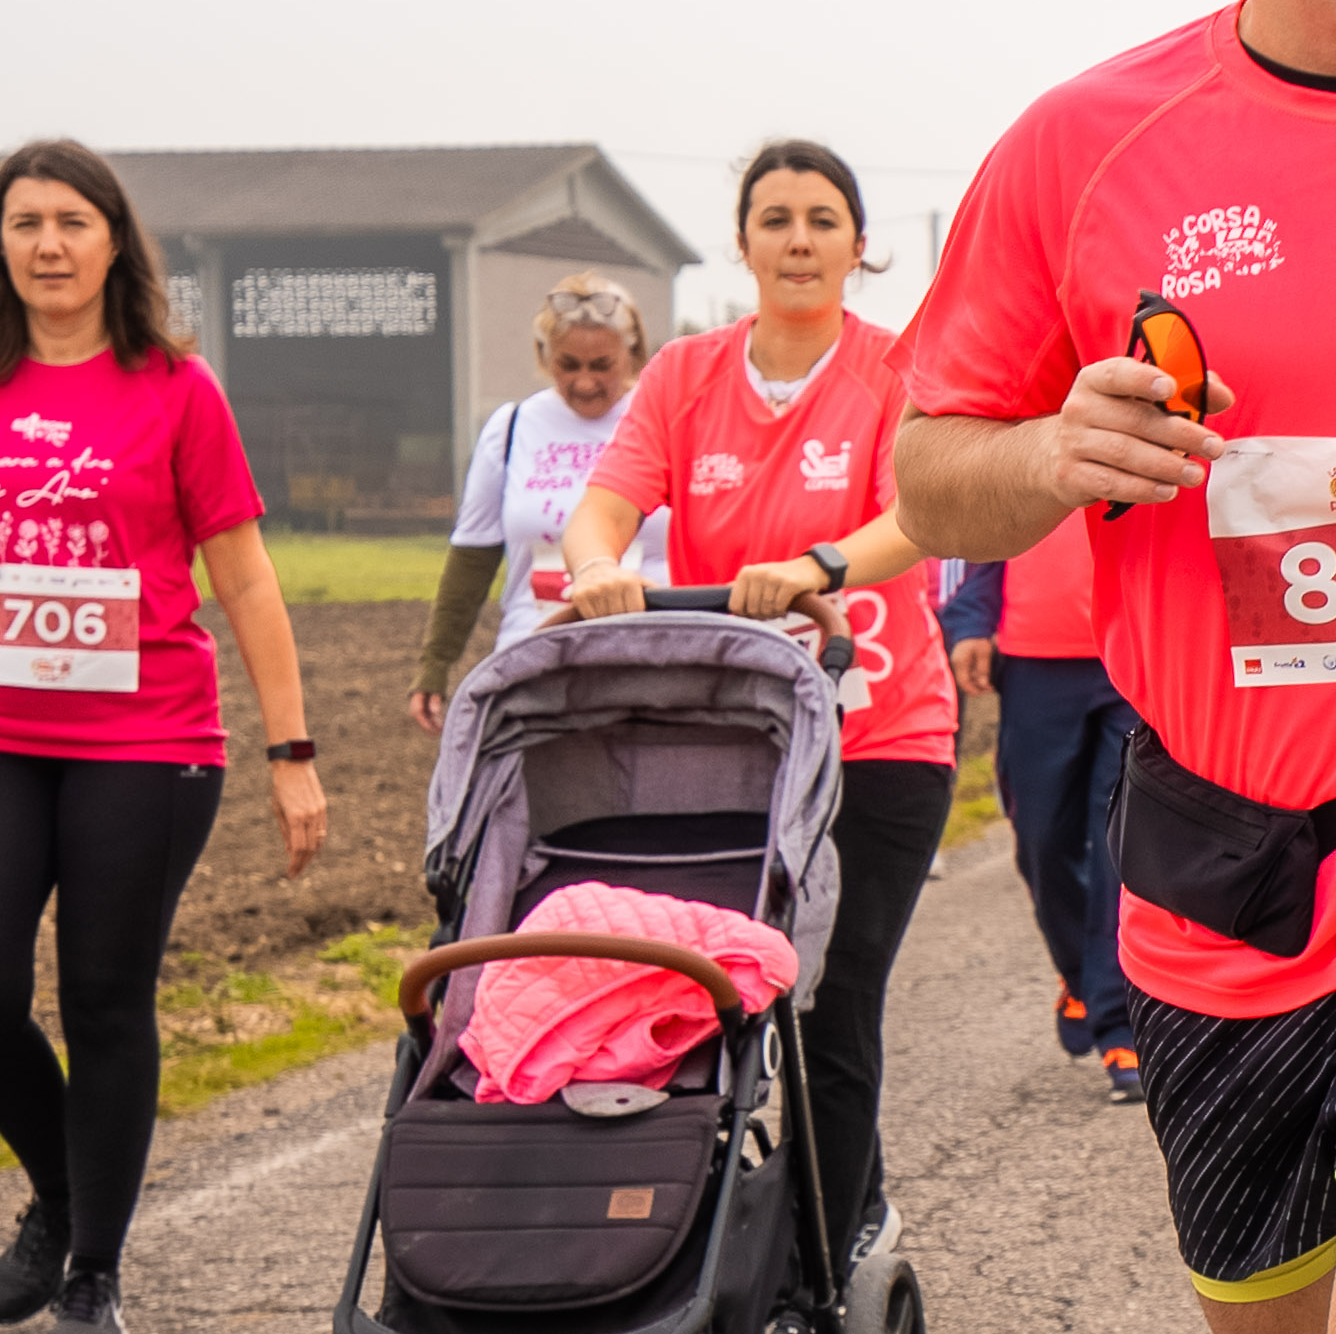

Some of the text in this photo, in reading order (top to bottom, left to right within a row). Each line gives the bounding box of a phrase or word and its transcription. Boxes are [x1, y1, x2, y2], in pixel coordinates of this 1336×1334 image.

[1182, 205, 1261, 237] CORSA
[1161, 267, 1222, 300] ROSA
[3, 597, 108, 646] 706
